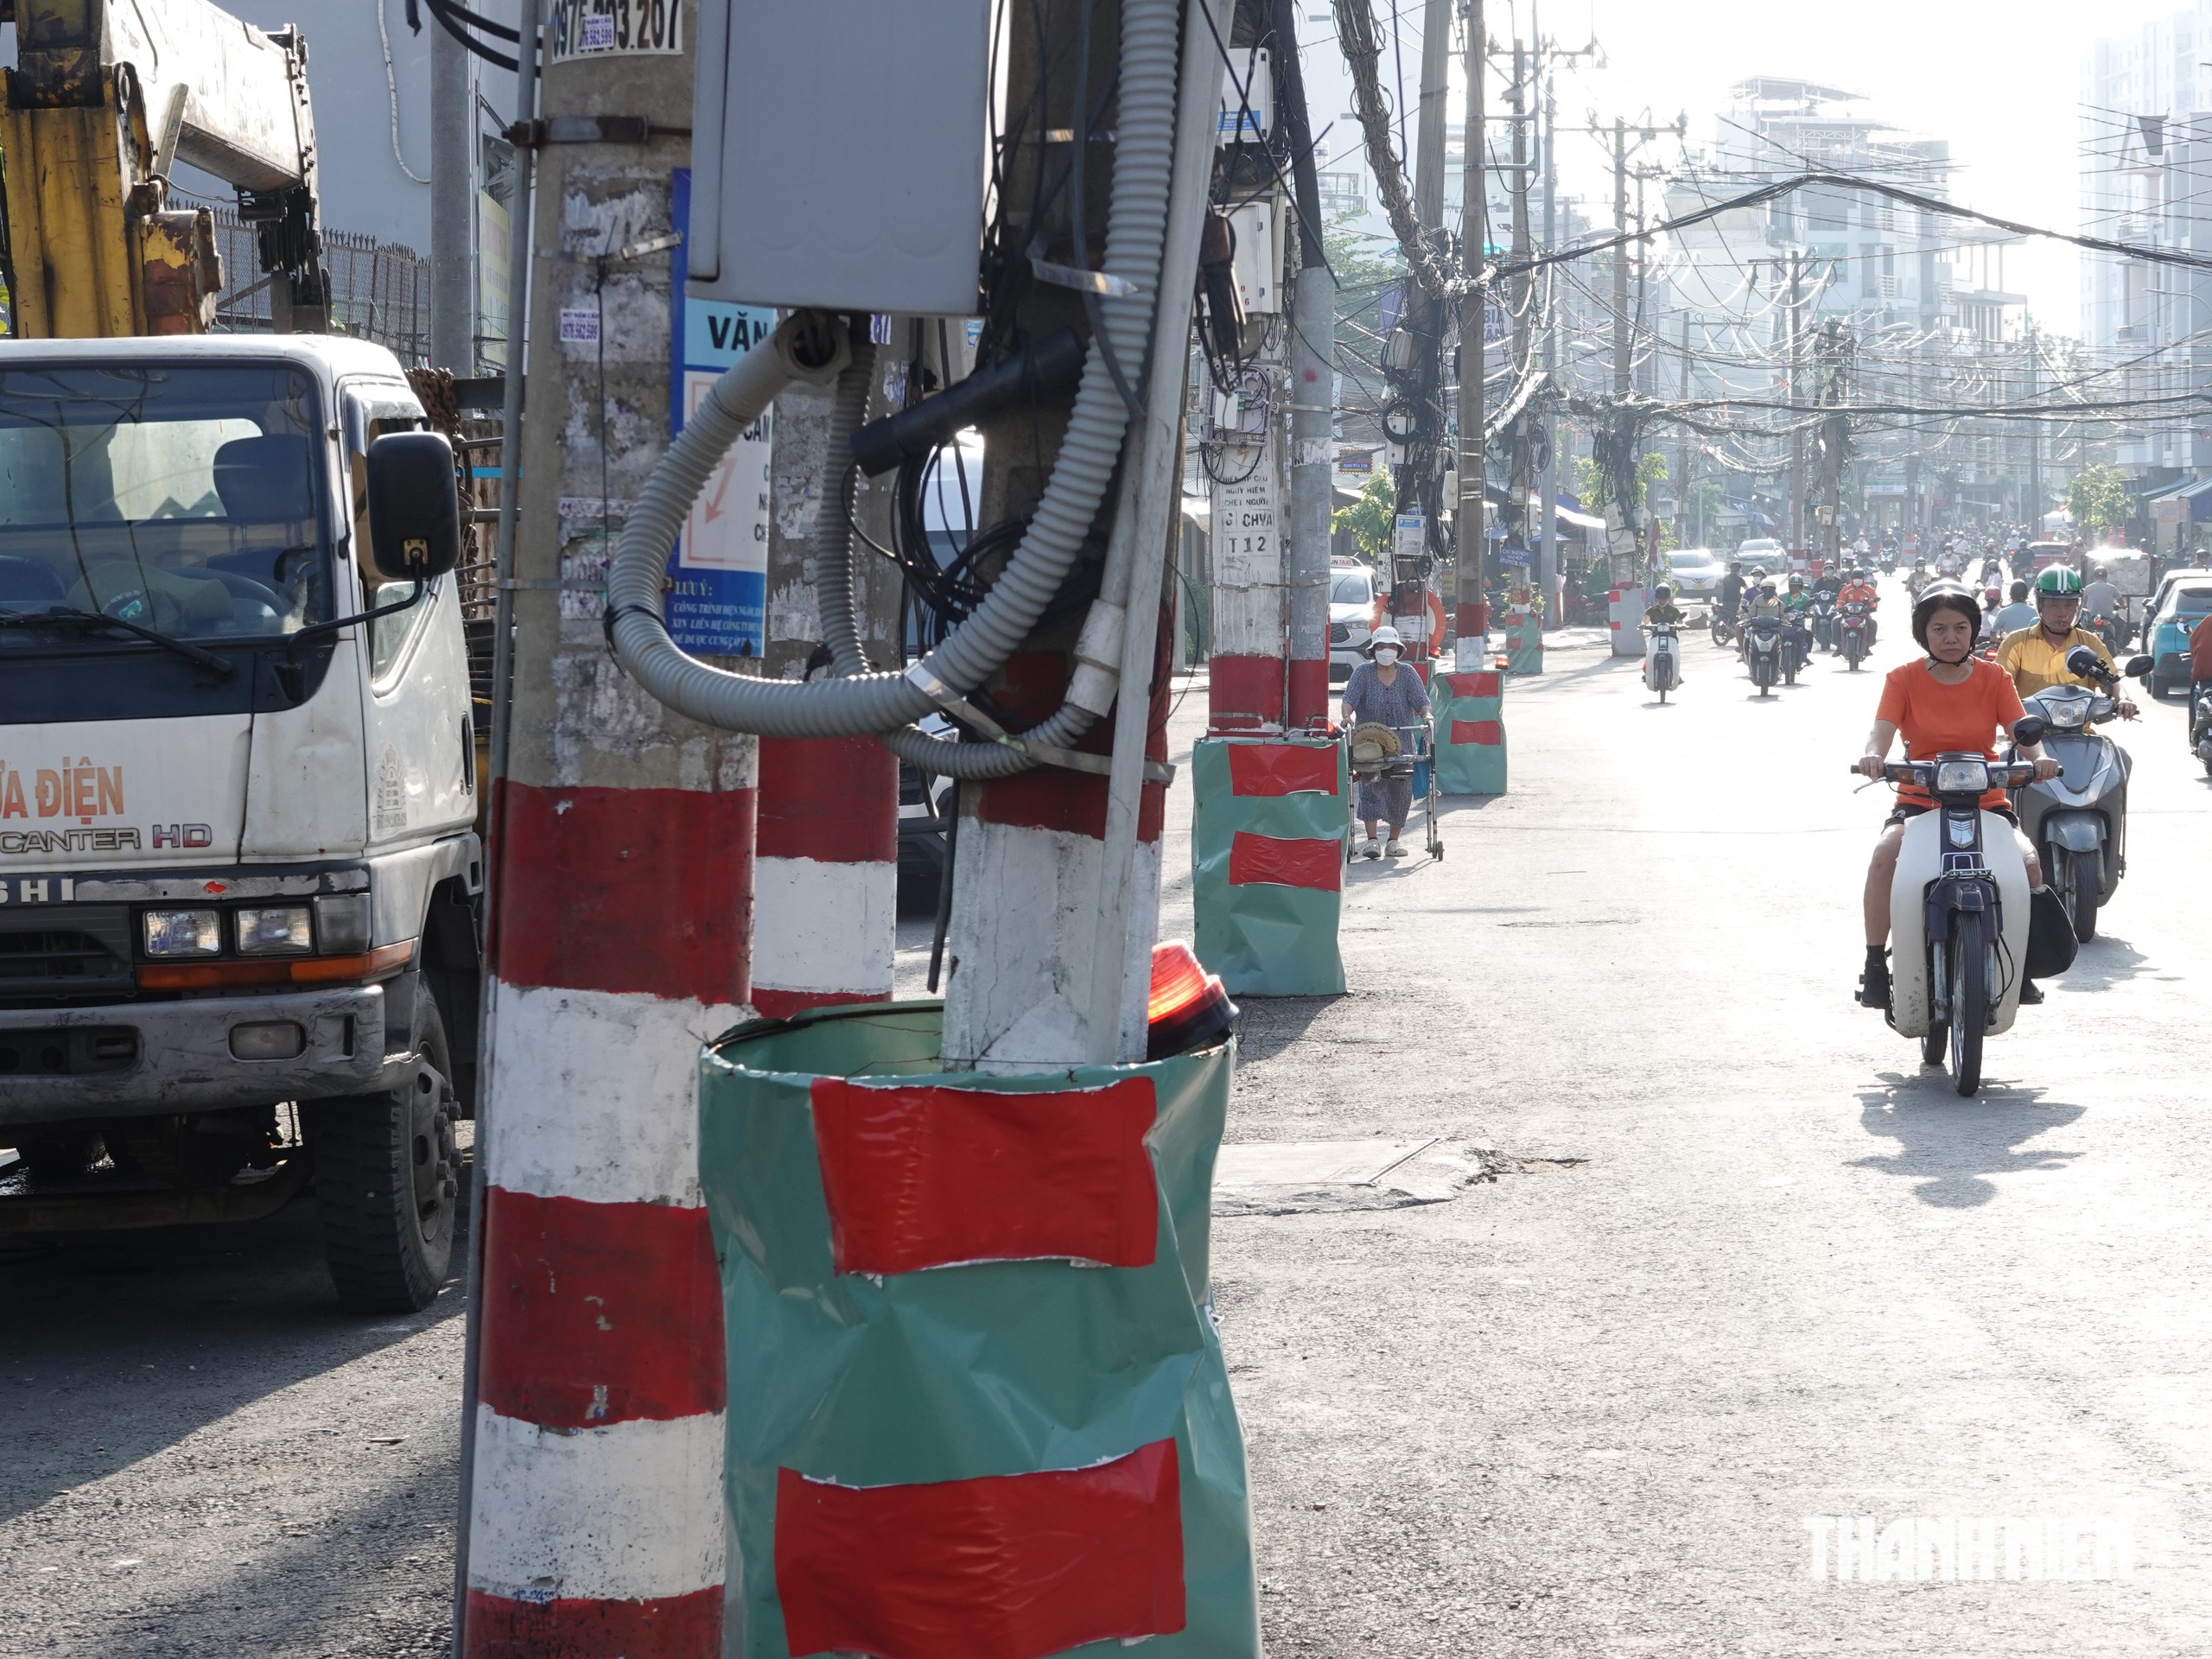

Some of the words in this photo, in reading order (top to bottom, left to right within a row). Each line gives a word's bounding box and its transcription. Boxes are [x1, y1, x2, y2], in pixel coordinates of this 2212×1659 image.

[708, 311, 768, 353] VĂN
[35, 755, 125, 825] ĐIỆN
[0, 827, 142, 854] CANTER
[152, 823, 213, 849] HD
